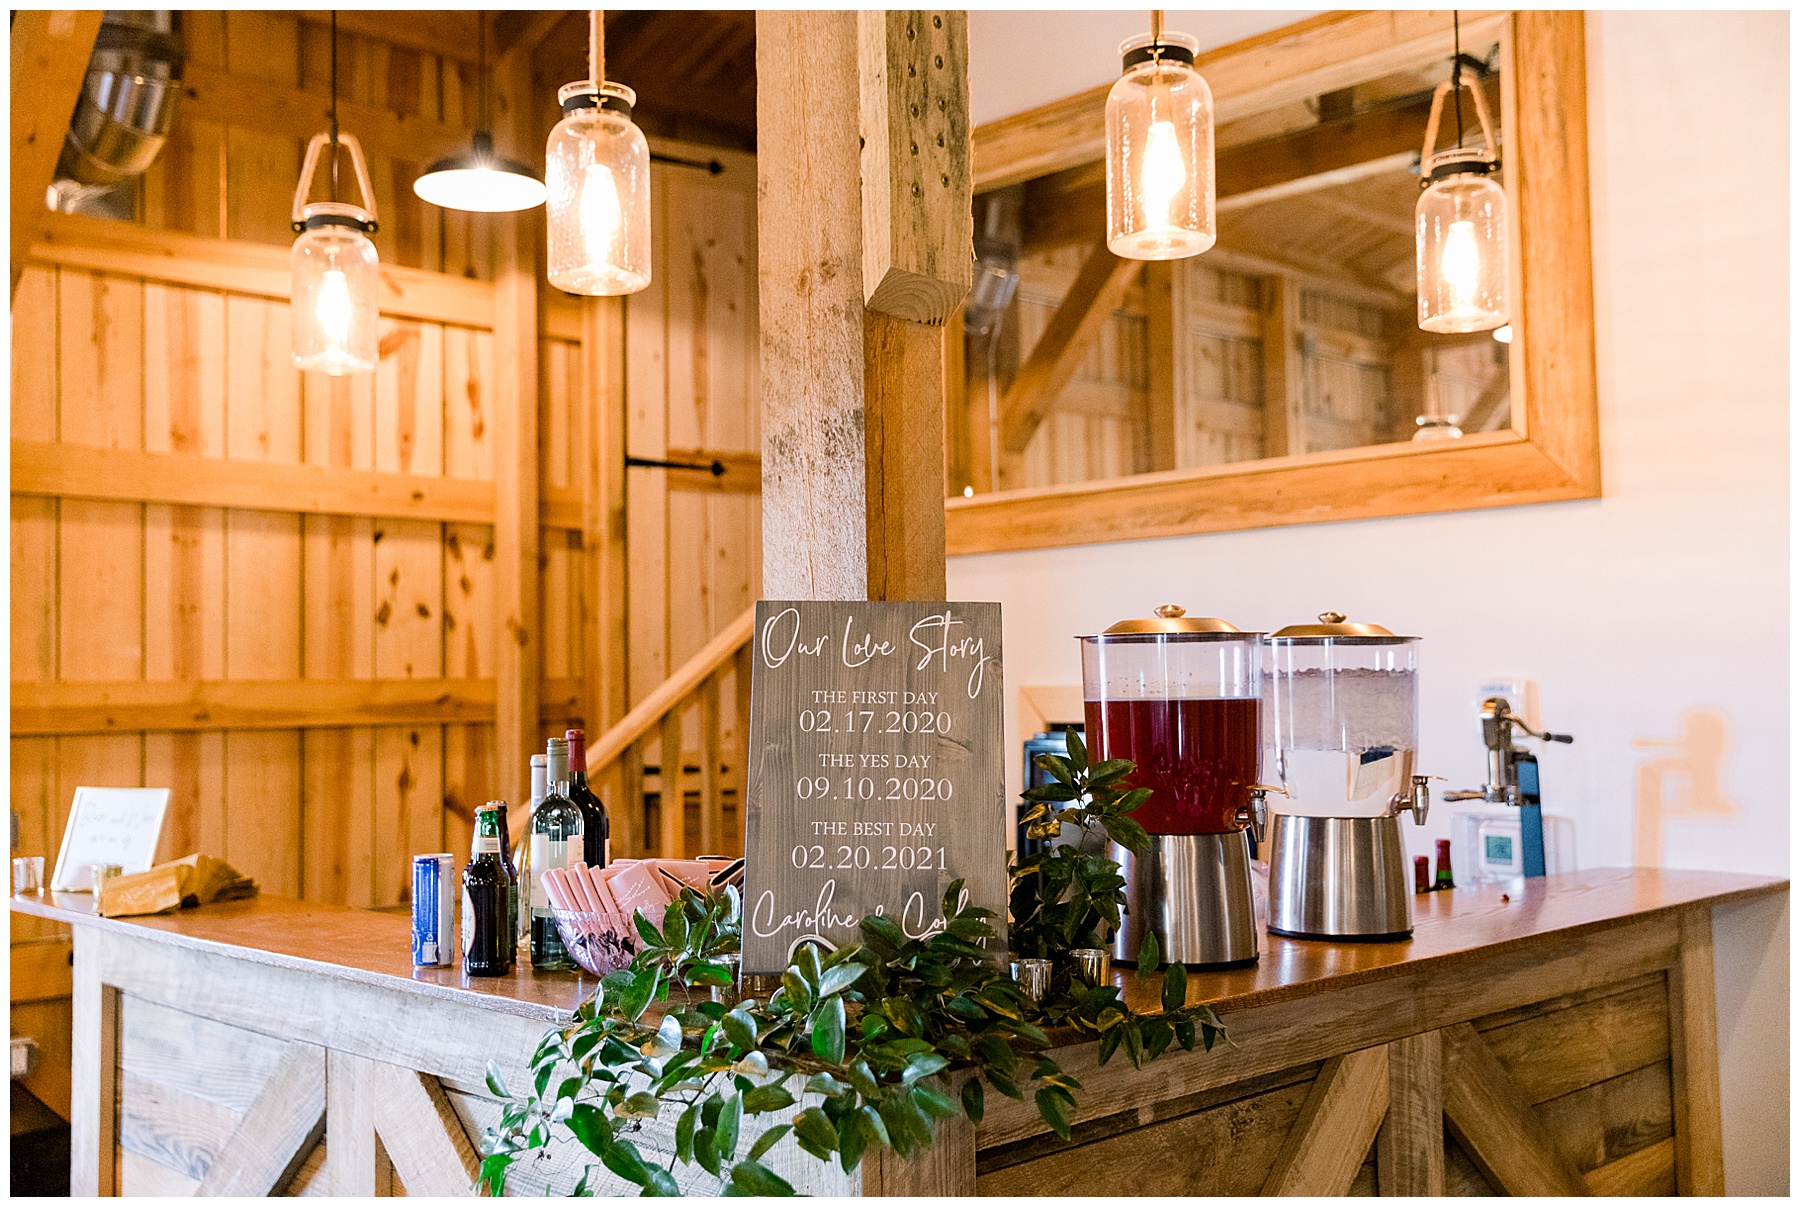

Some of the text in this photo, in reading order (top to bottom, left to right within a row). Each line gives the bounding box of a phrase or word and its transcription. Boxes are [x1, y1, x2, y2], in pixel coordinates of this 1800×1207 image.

[762, 608, 990, 699] Our Love Story
[811, 690, 938, 705] THE FIRST DAY
[799, 710, 952, 734] 02.17.2020
[819, 753, 931, 769] THE YES DAY
[797, 777, 953, 801] 09.10.2020
[811, 821, 936, 837] THE BEST DAY
[792, 845, 947, 870] 02.20.2021
[752, 879, 858, 938] Caroline
